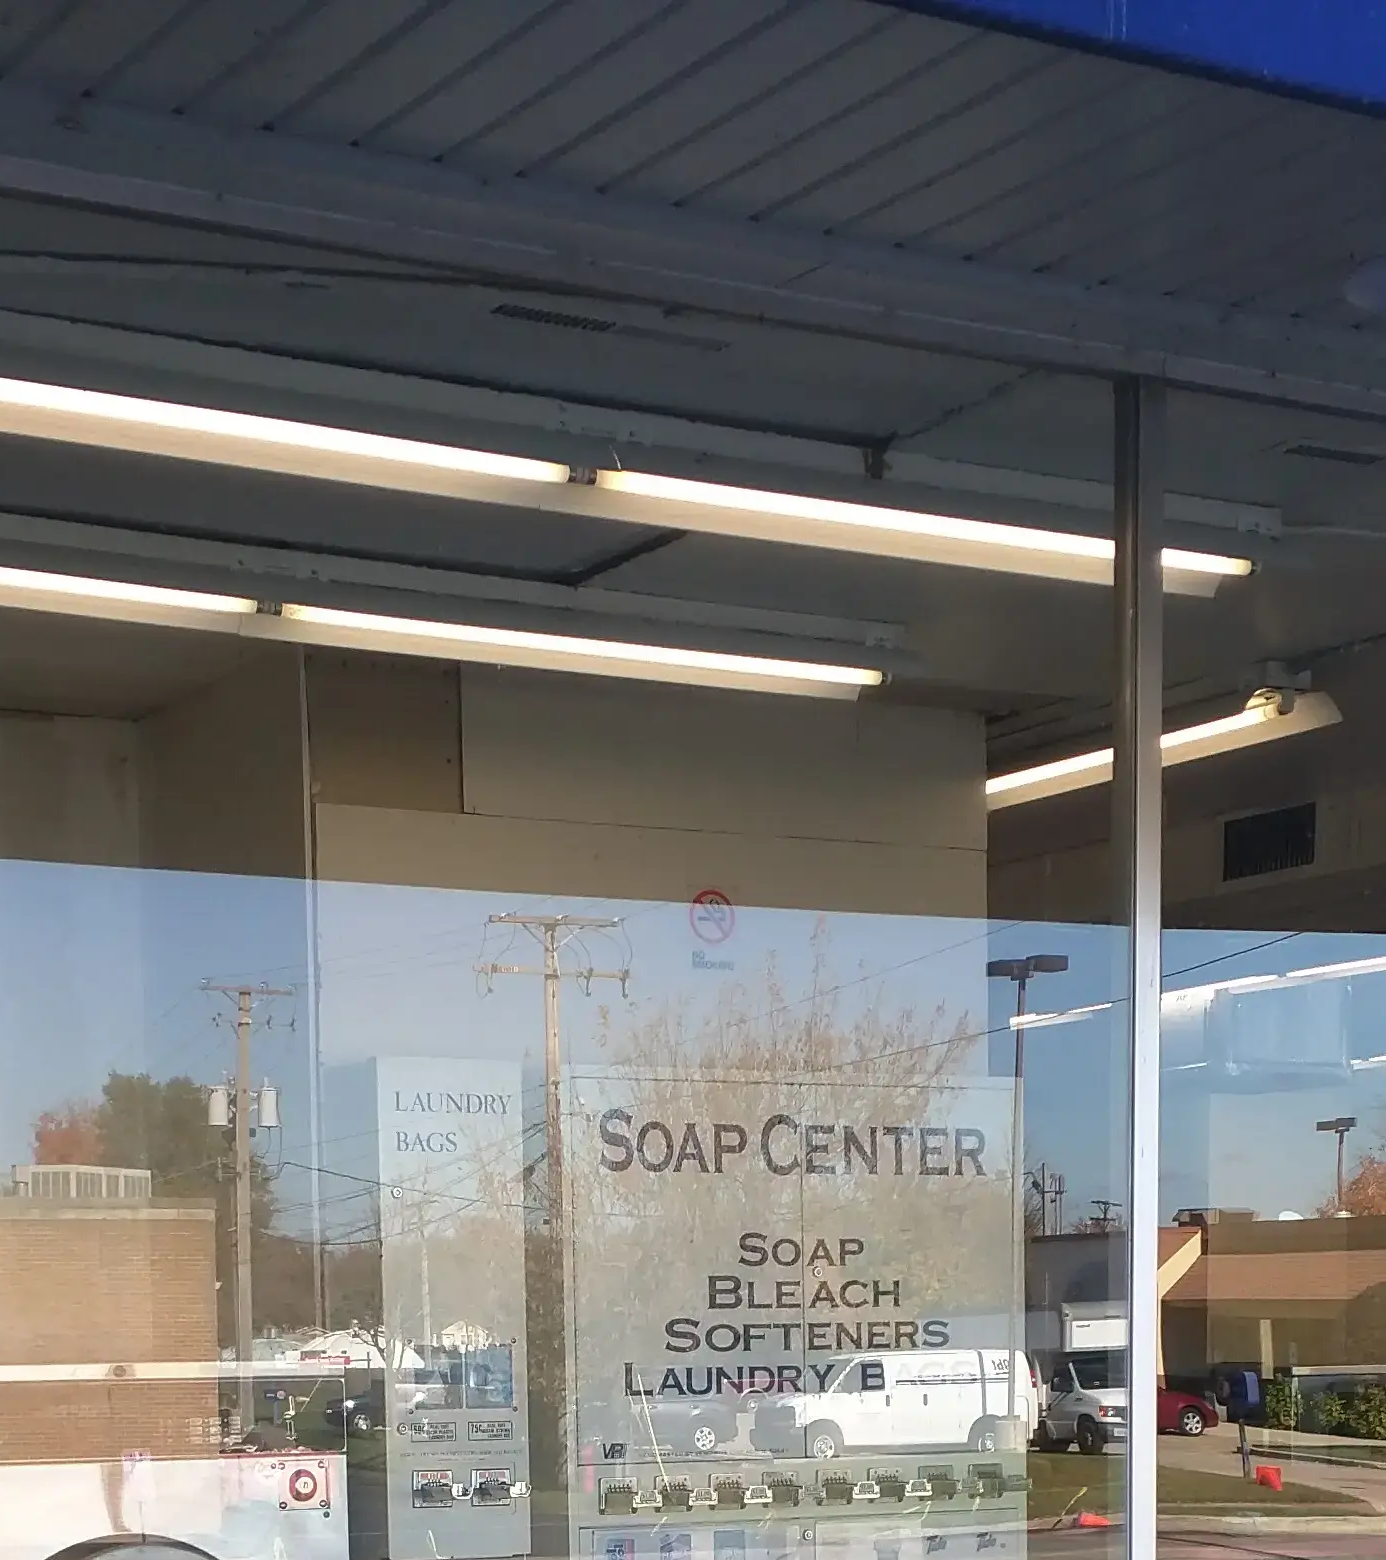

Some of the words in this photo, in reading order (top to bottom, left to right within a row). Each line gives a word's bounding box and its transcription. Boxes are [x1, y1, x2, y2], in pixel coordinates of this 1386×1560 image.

[394, 1091, 512, 1115] LAUNDRY
[395, 1131, 458, 1153] BAGS
[599, 1108, 748, 1173] SOAP
[760, 1113, 987, 1176] CENTER
[738, 1232, 865, 1267] SOAP
[708, 1275, 902, 1310] BLEACH
[665, 1317, 951, 1352] SOFTENERS
[624, 1361, 835, 1396] LAUNDRY
